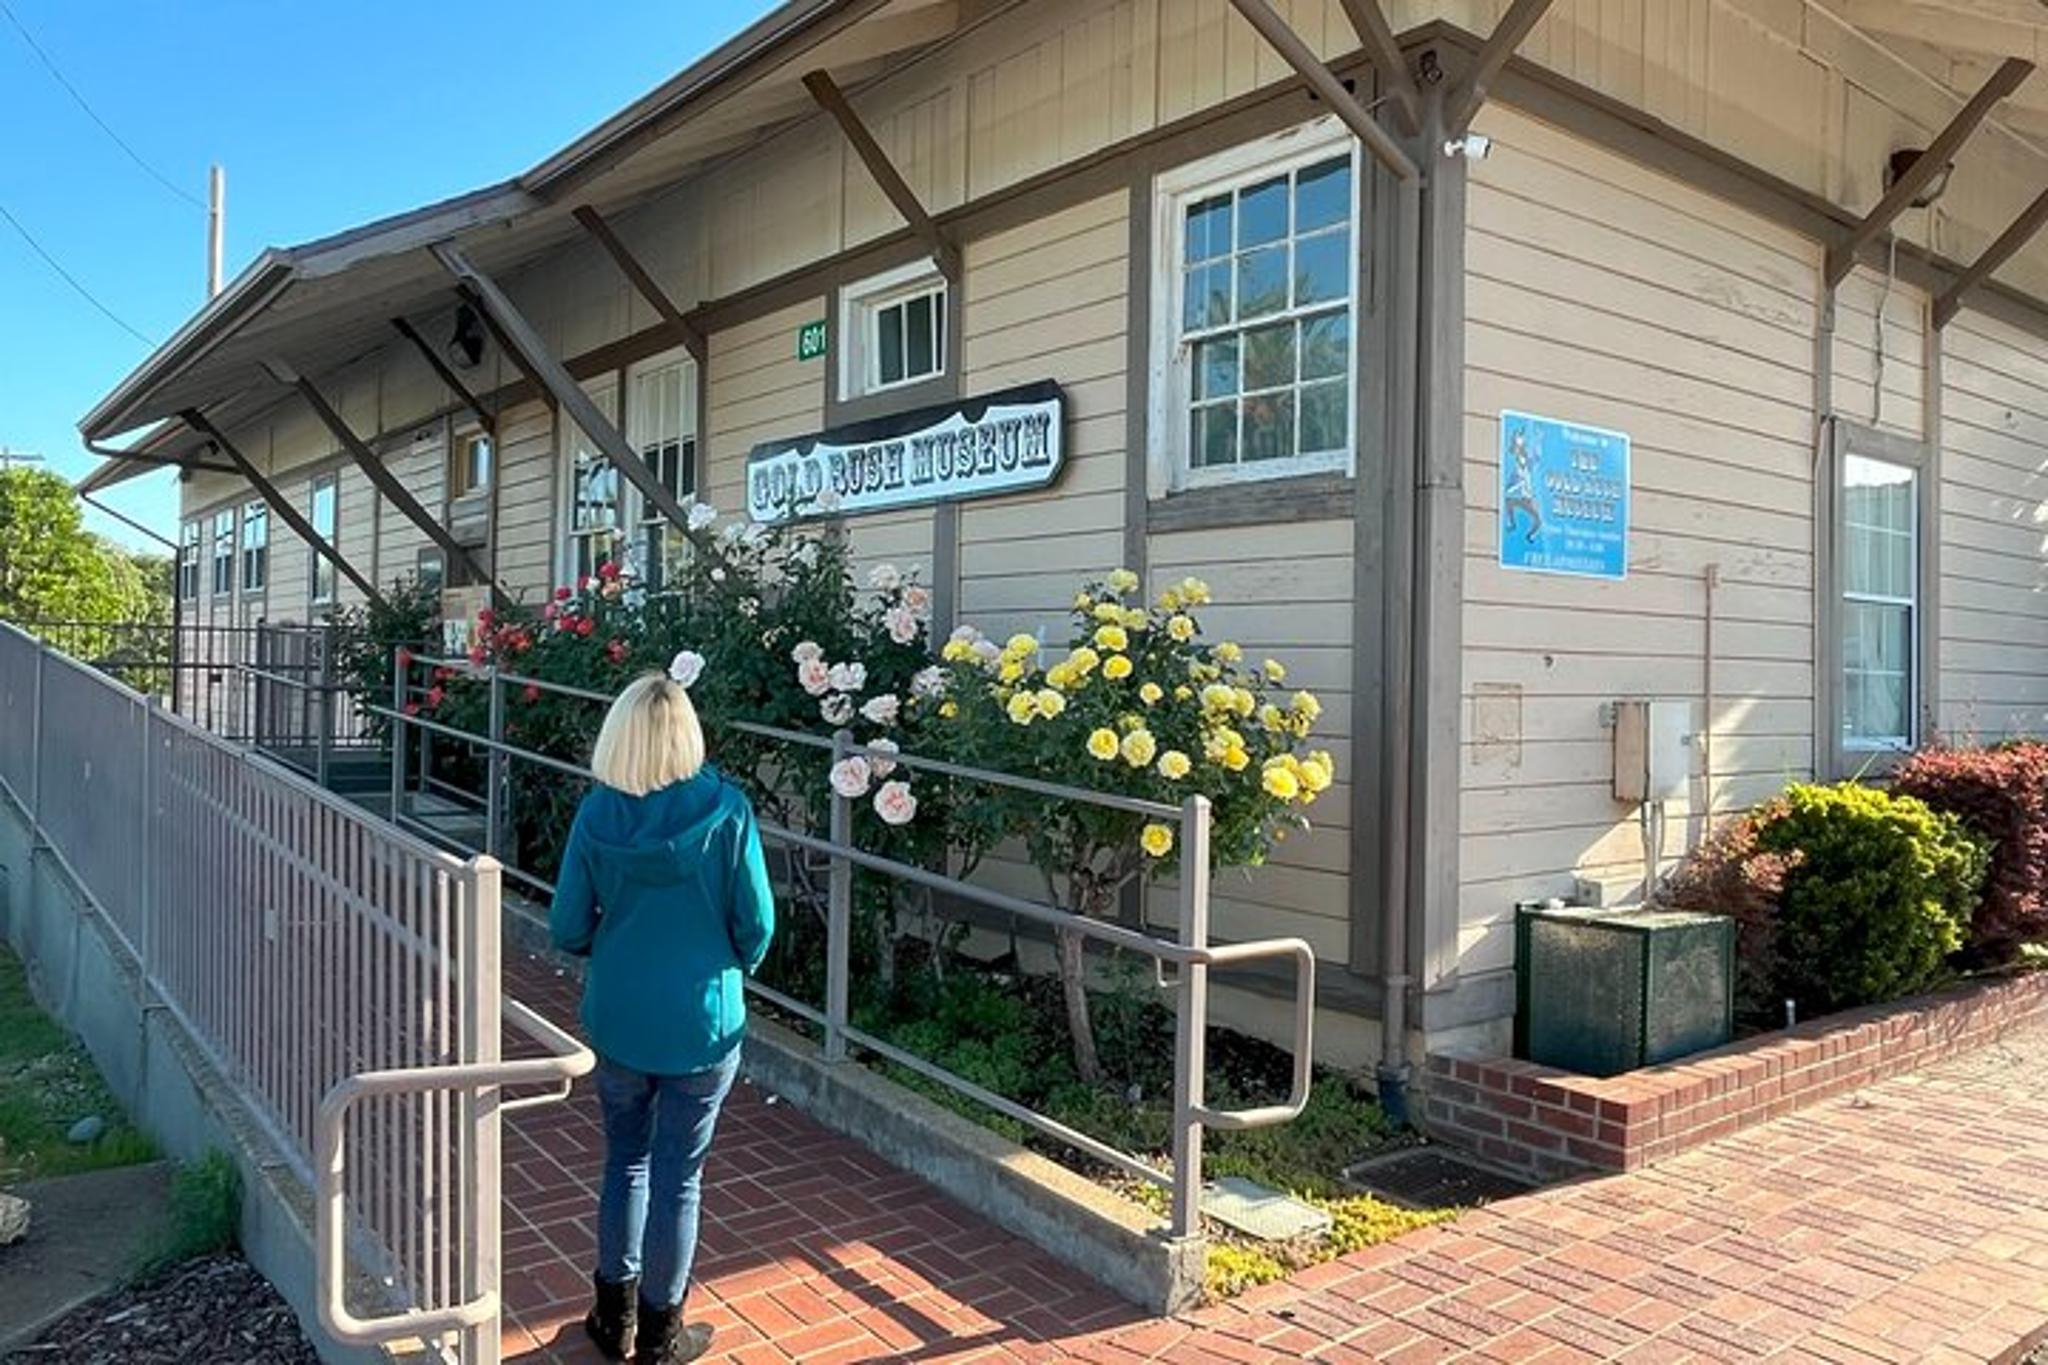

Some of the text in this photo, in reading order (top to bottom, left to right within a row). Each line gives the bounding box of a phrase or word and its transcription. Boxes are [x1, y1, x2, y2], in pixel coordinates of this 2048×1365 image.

[802, 325, 826, 356] 601
[754, 412, 1050, 510] GOLD RUSH MUSEUM
